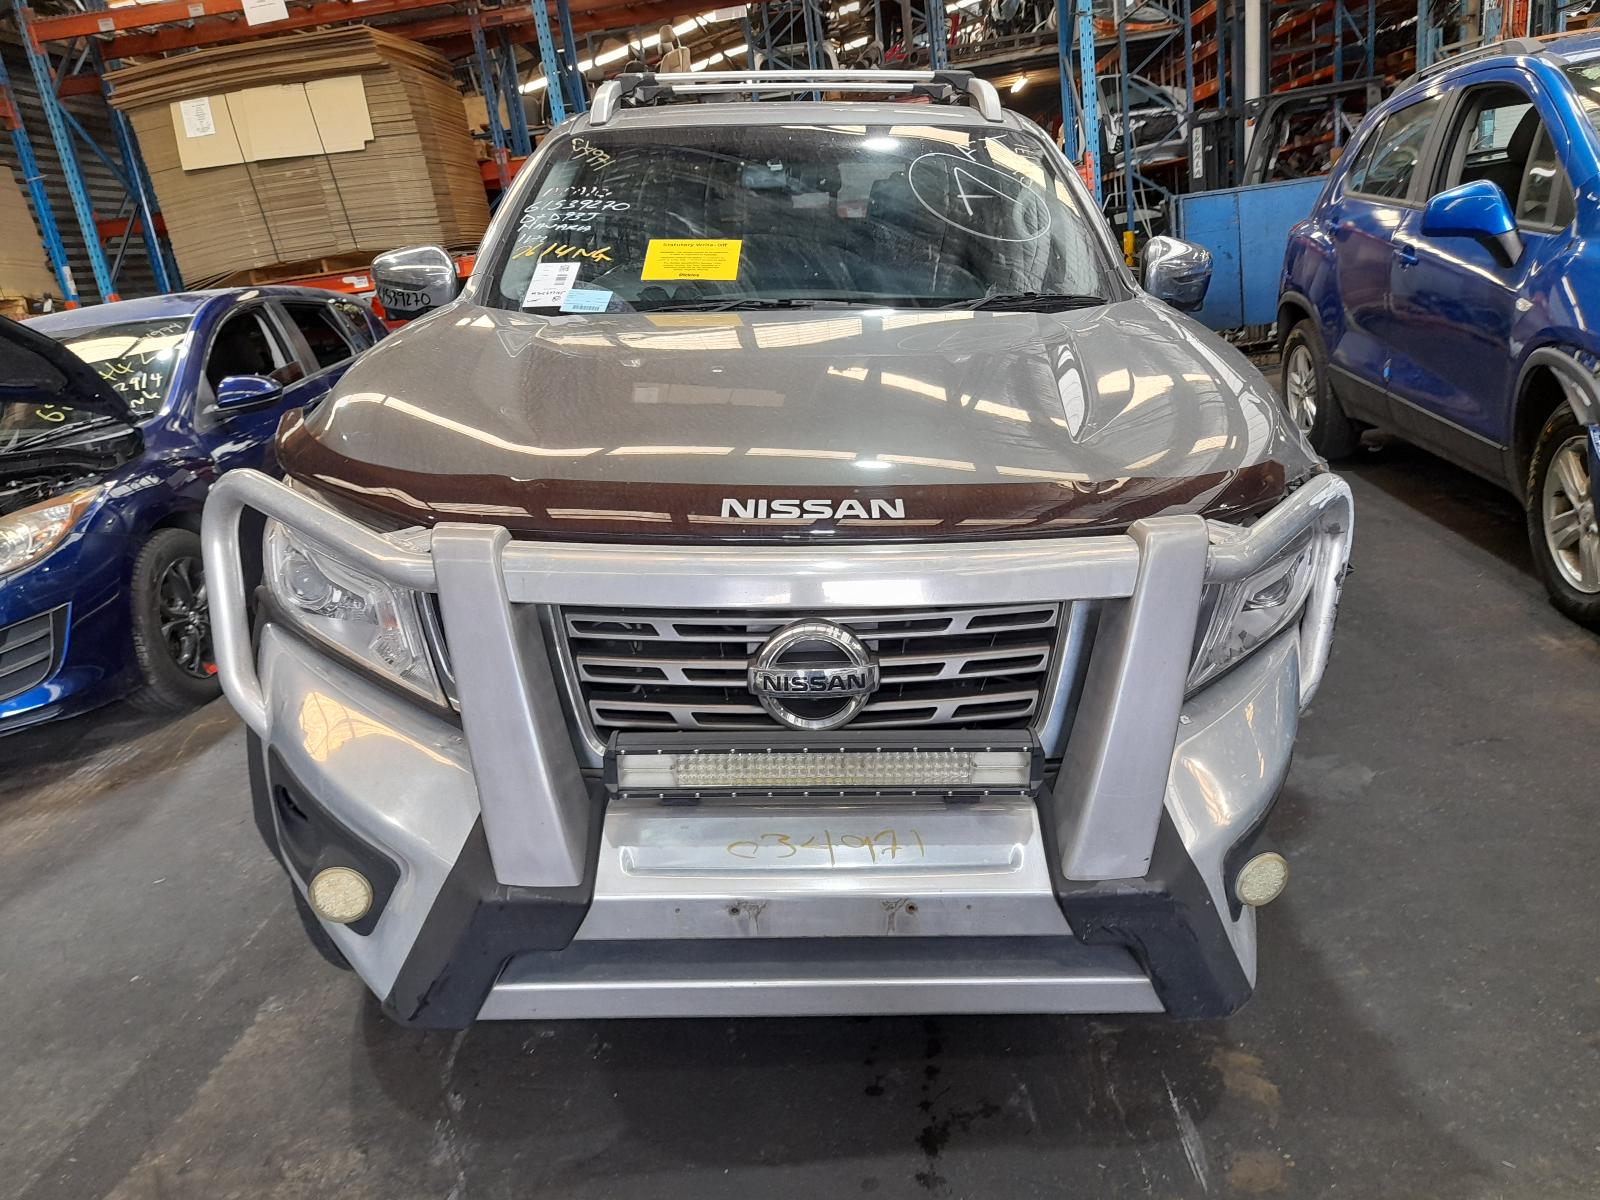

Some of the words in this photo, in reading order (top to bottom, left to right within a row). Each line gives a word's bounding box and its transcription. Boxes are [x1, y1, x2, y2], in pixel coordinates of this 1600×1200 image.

[720, 498, 906, 519] NISSAN
[762, 674, 866, 692] NISSAN
[727, 829, 925, 866] 034971
